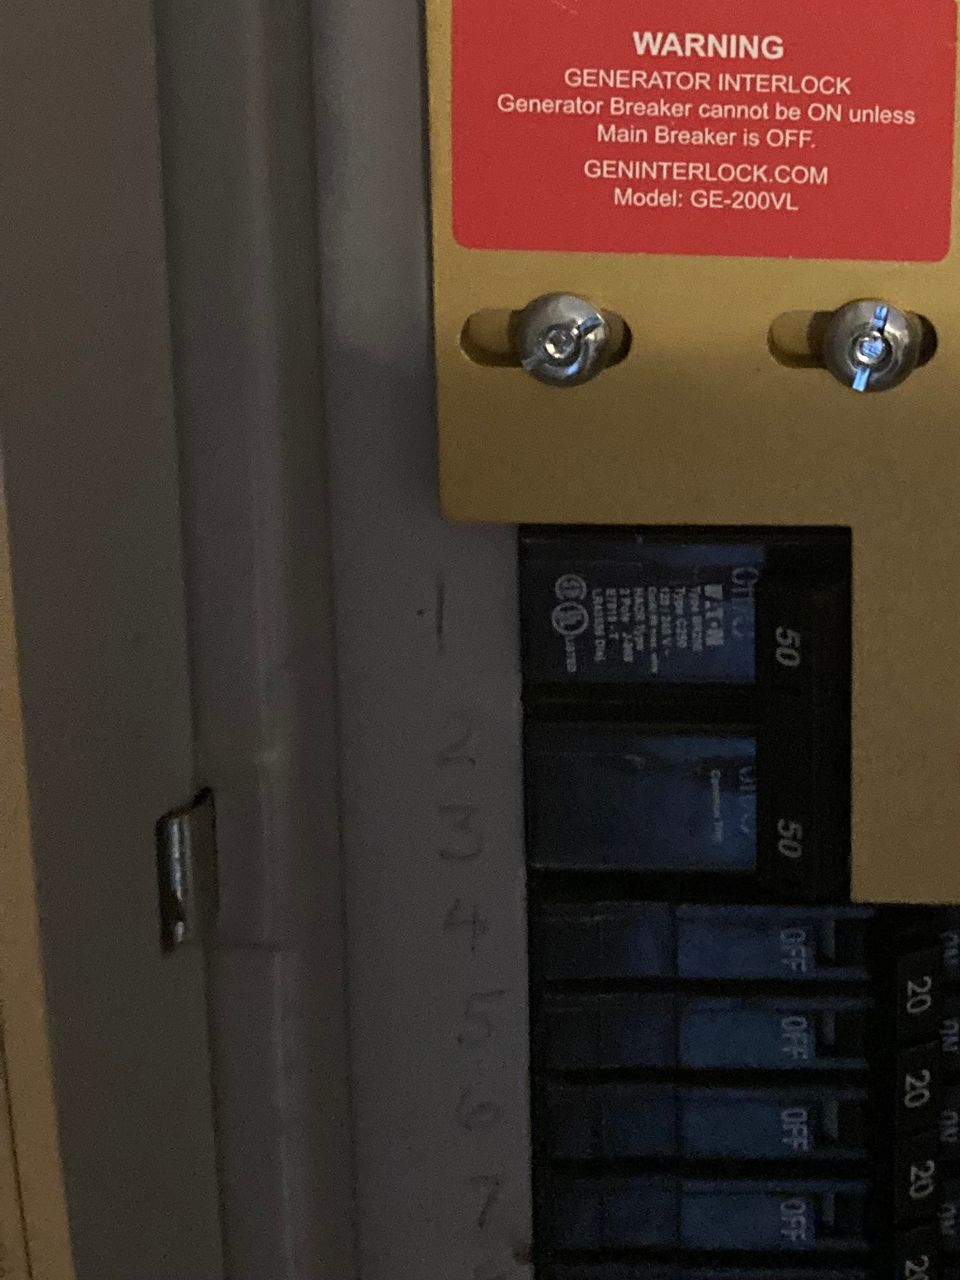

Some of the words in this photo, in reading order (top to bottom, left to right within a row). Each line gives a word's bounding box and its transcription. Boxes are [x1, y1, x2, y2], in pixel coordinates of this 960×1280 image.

[632, 31, 785, 60] WARNING
[564, 67, 712, 92] GENERATOR
[717, 72, 852, 96] INTERLOCK
[497, 93, 604, 116] Generator
[609, 96, 693, 119] Breaker
[698, 100, 769, 121] cannot
[774, 101, 801, 121] be
[806, 104, 842, 123] ON
[848, 105, 915, 125] unless
[596, 123, 648, 145] Main
[654, 125, 737, 147] Breaker
[742, 128, 761, 148] is
[766, 128, 816, 149] OFF.
[583, 158, 829, 186] GENINTERLOCK.COM
[614, 187, 683, 208] Model:
[690, 189, 799, 211] GE-200VL
[776, 624, 801, 668] 50
[778, 819, 803, 859] 50
[779, 926, 808, 973] OFF
[906, 976, 932, 1015] 20
[781, 1015, 809, 1061] OFF
[904, 1069, 931, 1110] 20
[780, 1106, 808, 1152] OFF
[908, 1160, 935, 1200] 20
[780, 1198, 807, 1242] OFF
